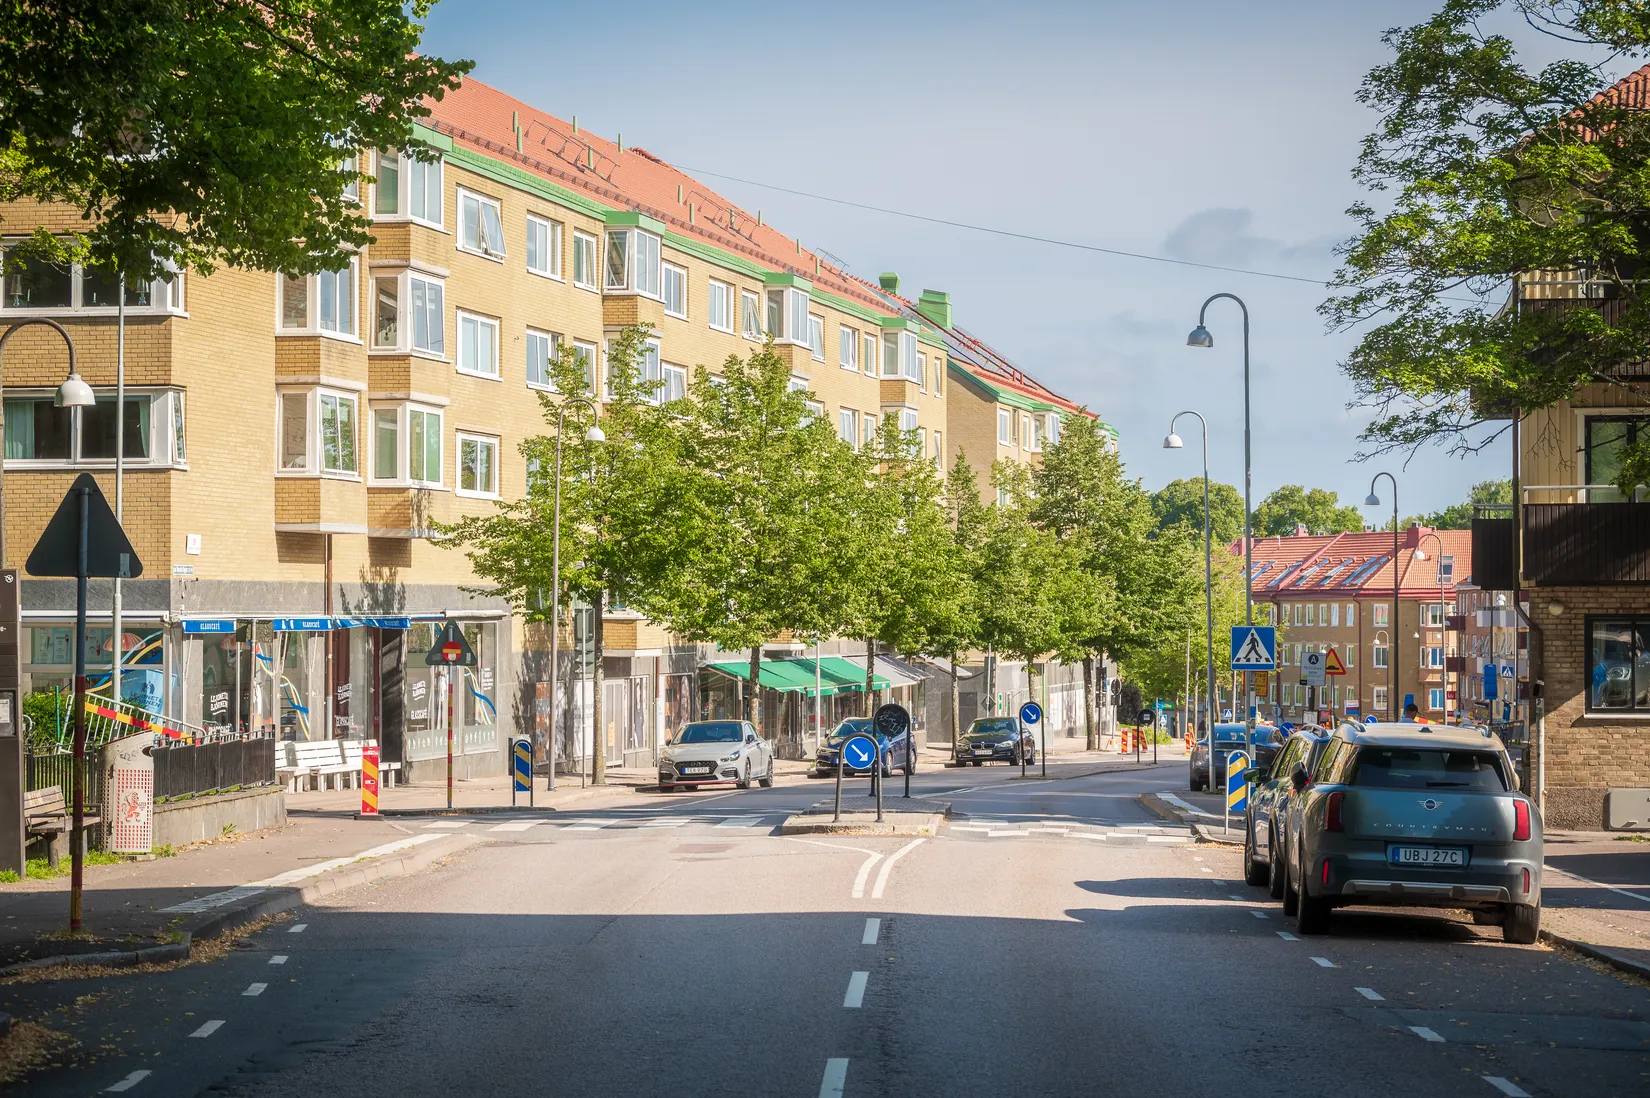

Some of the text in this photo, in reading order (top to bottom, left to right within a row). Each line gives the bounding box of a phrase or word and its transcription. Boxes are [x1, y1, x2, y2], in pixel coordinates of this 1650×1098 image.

[1310, 655, 1317, 663] A
[1373, 823, 1487, 832] COUNTRYMAN
[1404, 849, 1458, 863] UBJ 27C
